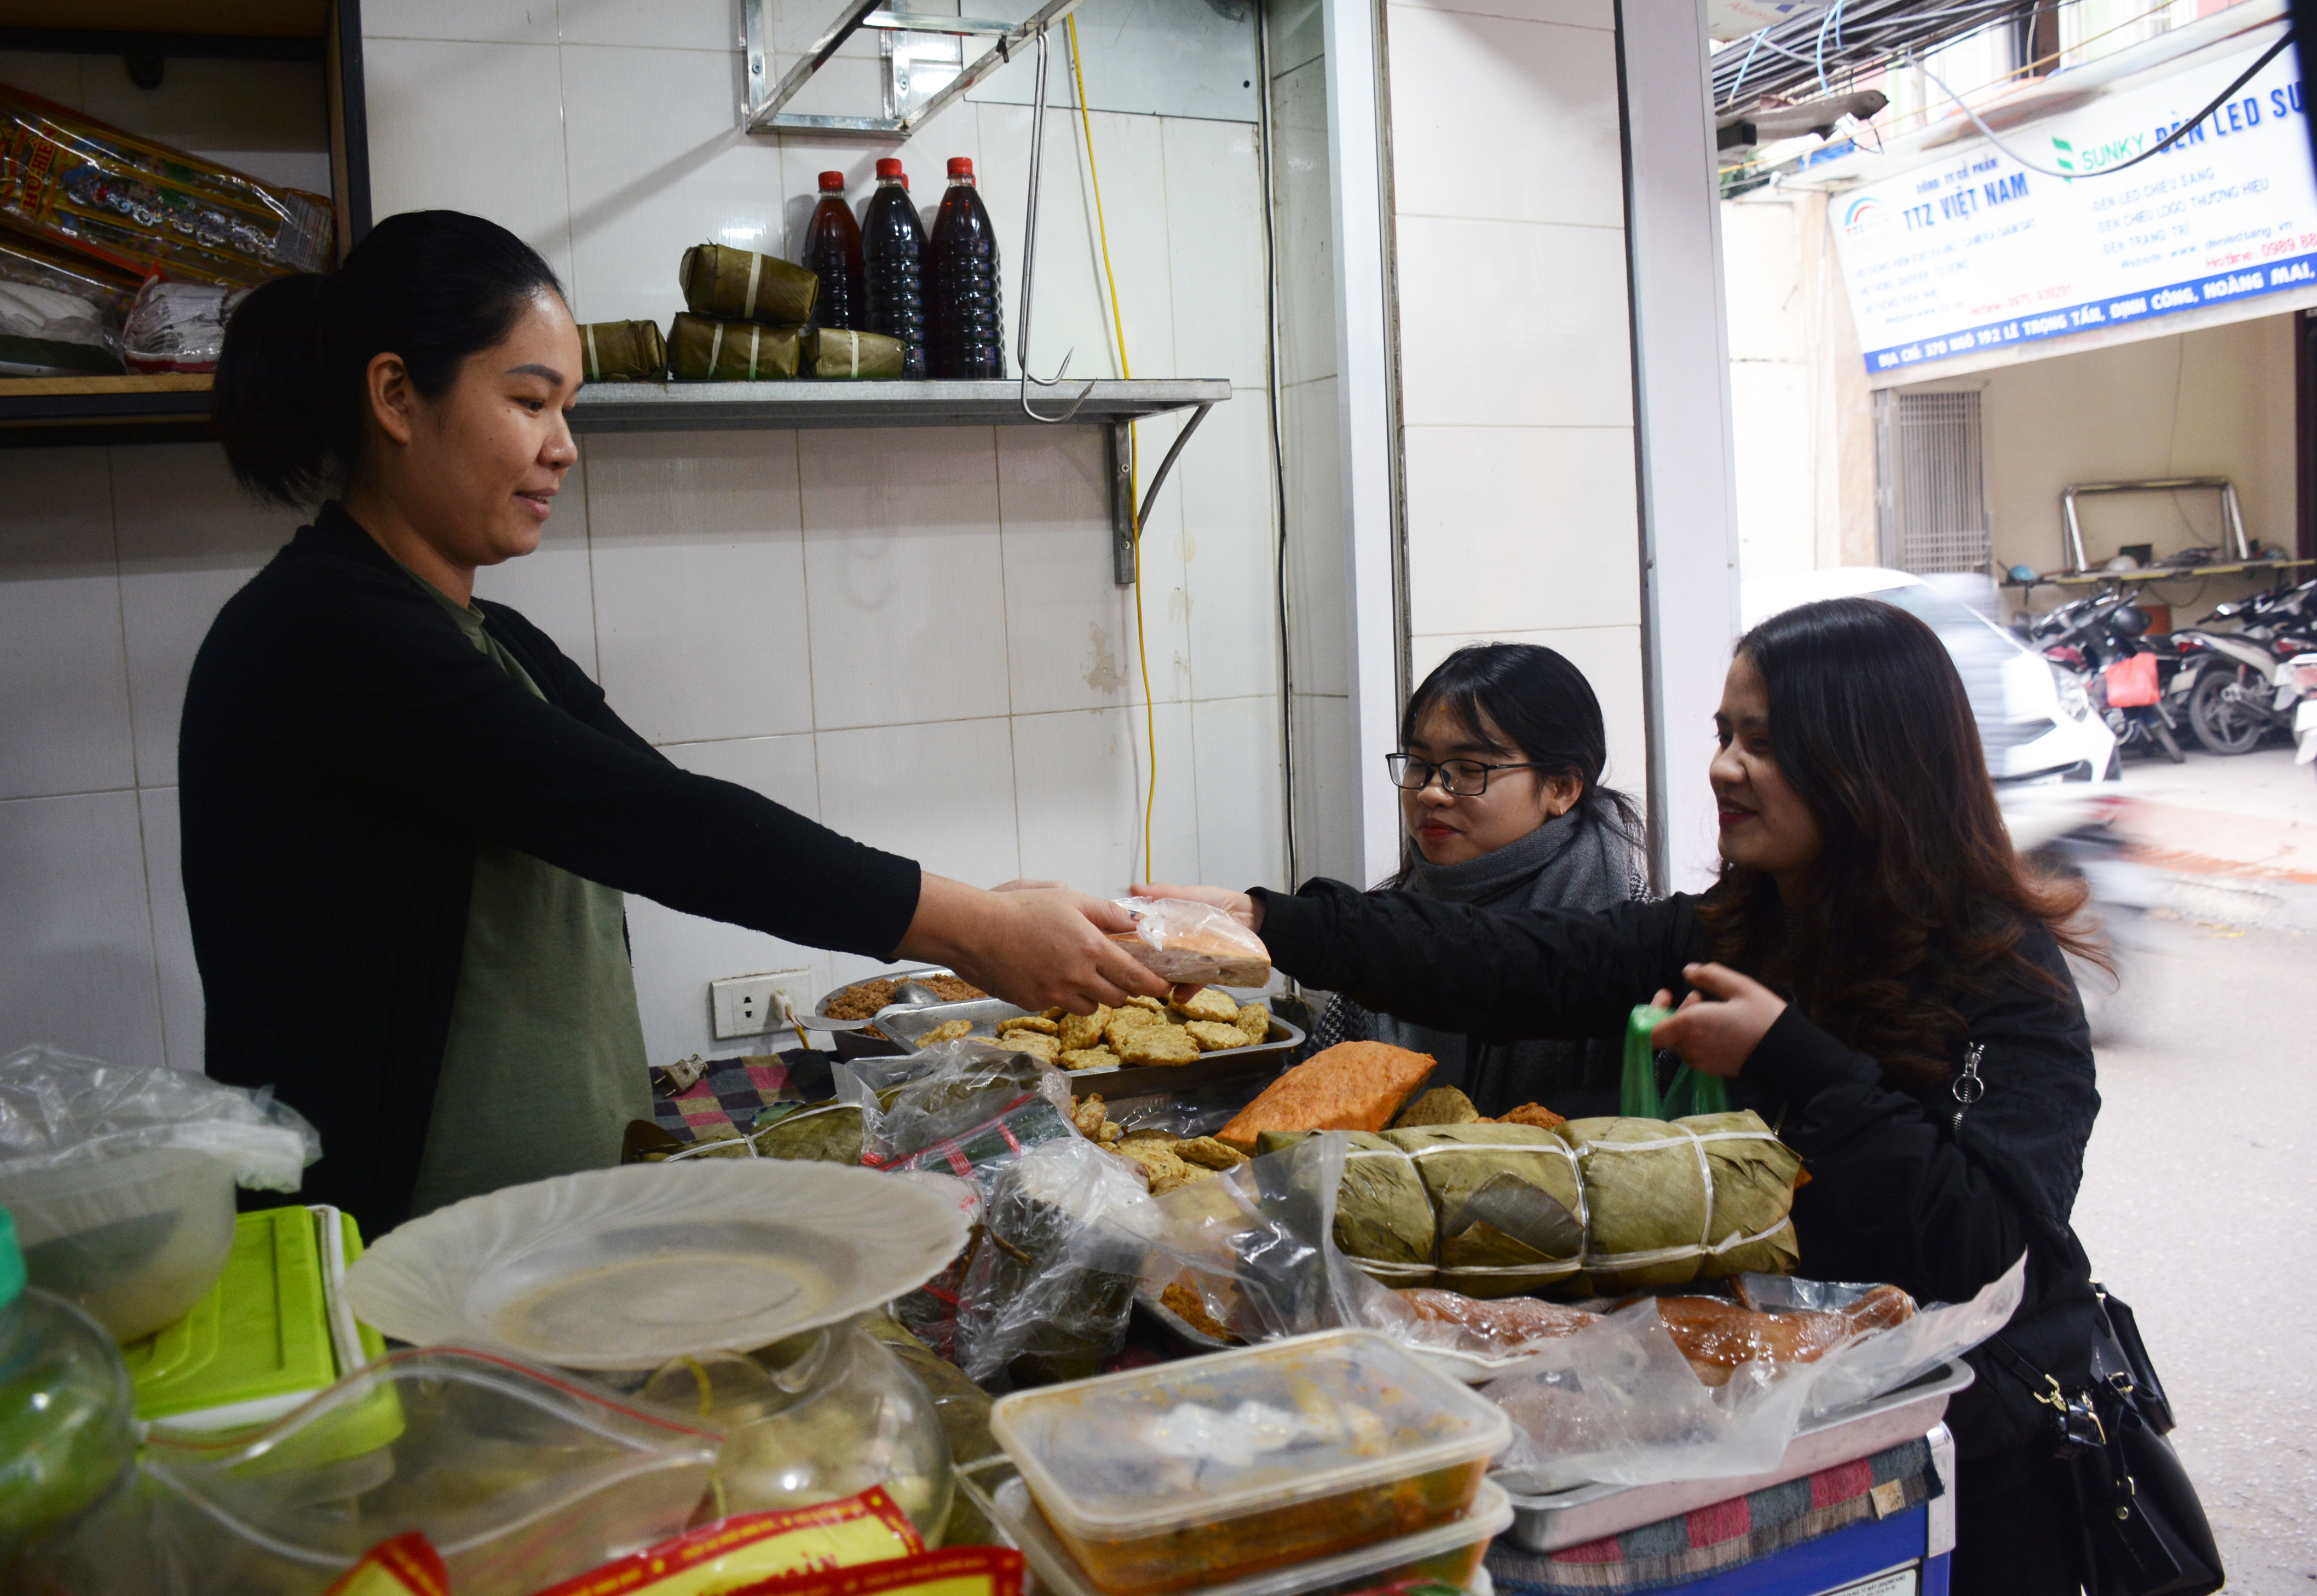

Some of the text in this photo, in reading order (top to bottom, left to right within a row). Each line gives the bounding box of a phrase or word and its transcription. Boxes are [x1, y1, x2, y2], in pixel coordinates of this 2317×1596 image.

[2213, 97, 2261, 136] LED
[2082, 133, 2143, 170] SUNKY
[1903, 203, 1934, 231] TTZ
[1940, 186, 1978, 221] VIỆT
[1984, 172, 2029, 206] NAM
[2119, 189, 2141, 205] LED
[2157, 200, 2186, 218] LOGO
[2191, 186, 2240, 208] THƯƠNG
[2243, 177, 2269, 198] HIỆU
[2129, 229, 2166, 246] TRANG
[1924, 339, 1947, 358] 370
[1976, 328, 2002, 346] 192
[2003, 321, 2020, 340] LÊ
[2022, 313, 2068, 337] TRỌNG
[2109, 296, 2147, 320] ĐỊNH
[2151, 286, 2199, 310] CÔNG,
[2203, 271, 2264, 300] HOÀNG
[2270, 261, 2315, 286] MAI,
